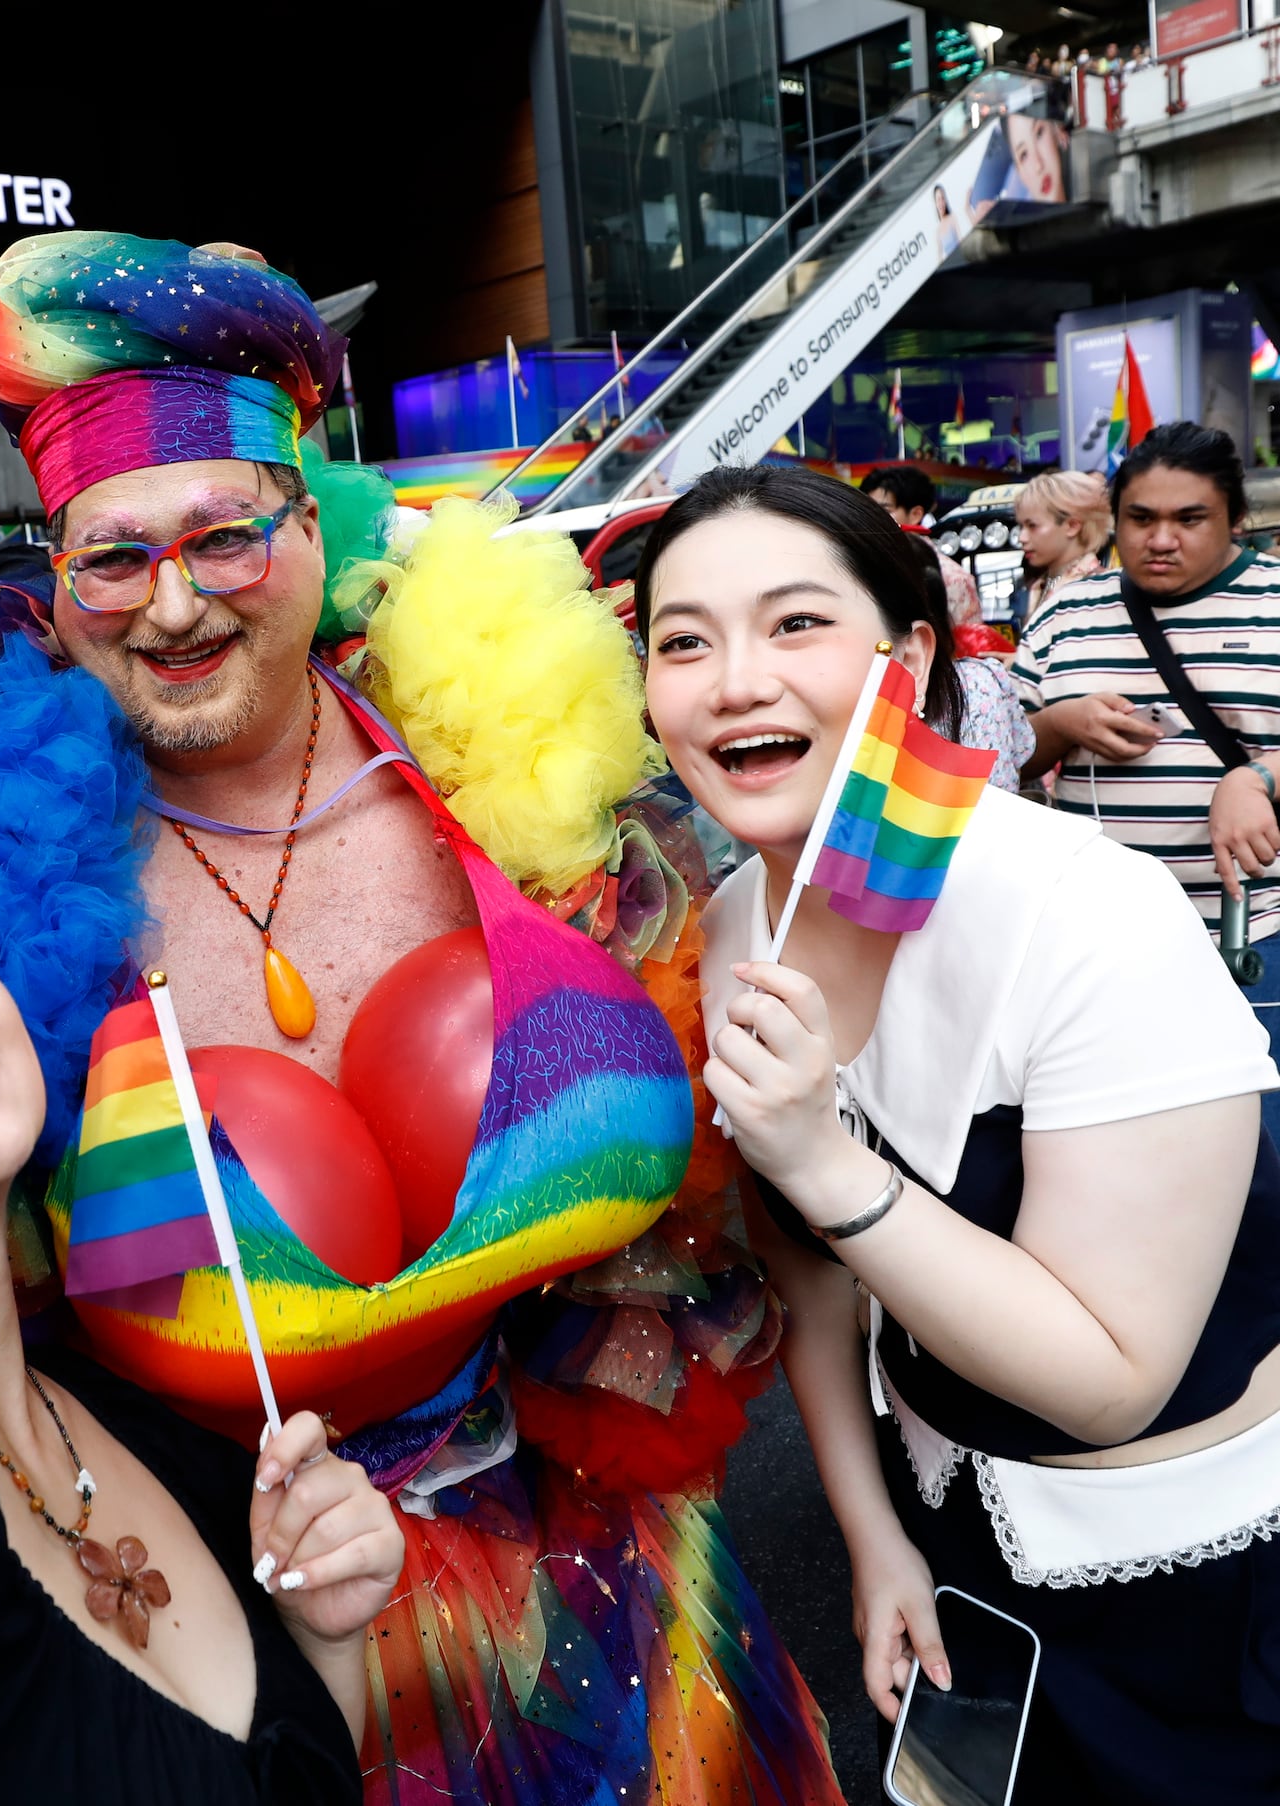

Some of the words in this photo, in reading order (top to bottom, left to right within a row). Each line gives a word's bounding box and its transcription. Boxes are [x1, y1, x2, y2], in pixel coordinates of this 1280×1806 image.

[708, 377, 790, 463] Welcome
[789, 357, 808, 382] to
[807, 283, 881, 363] Samsung
[877, 230, 928, 290] Station
[978, 487, 1014, 501] TAX
